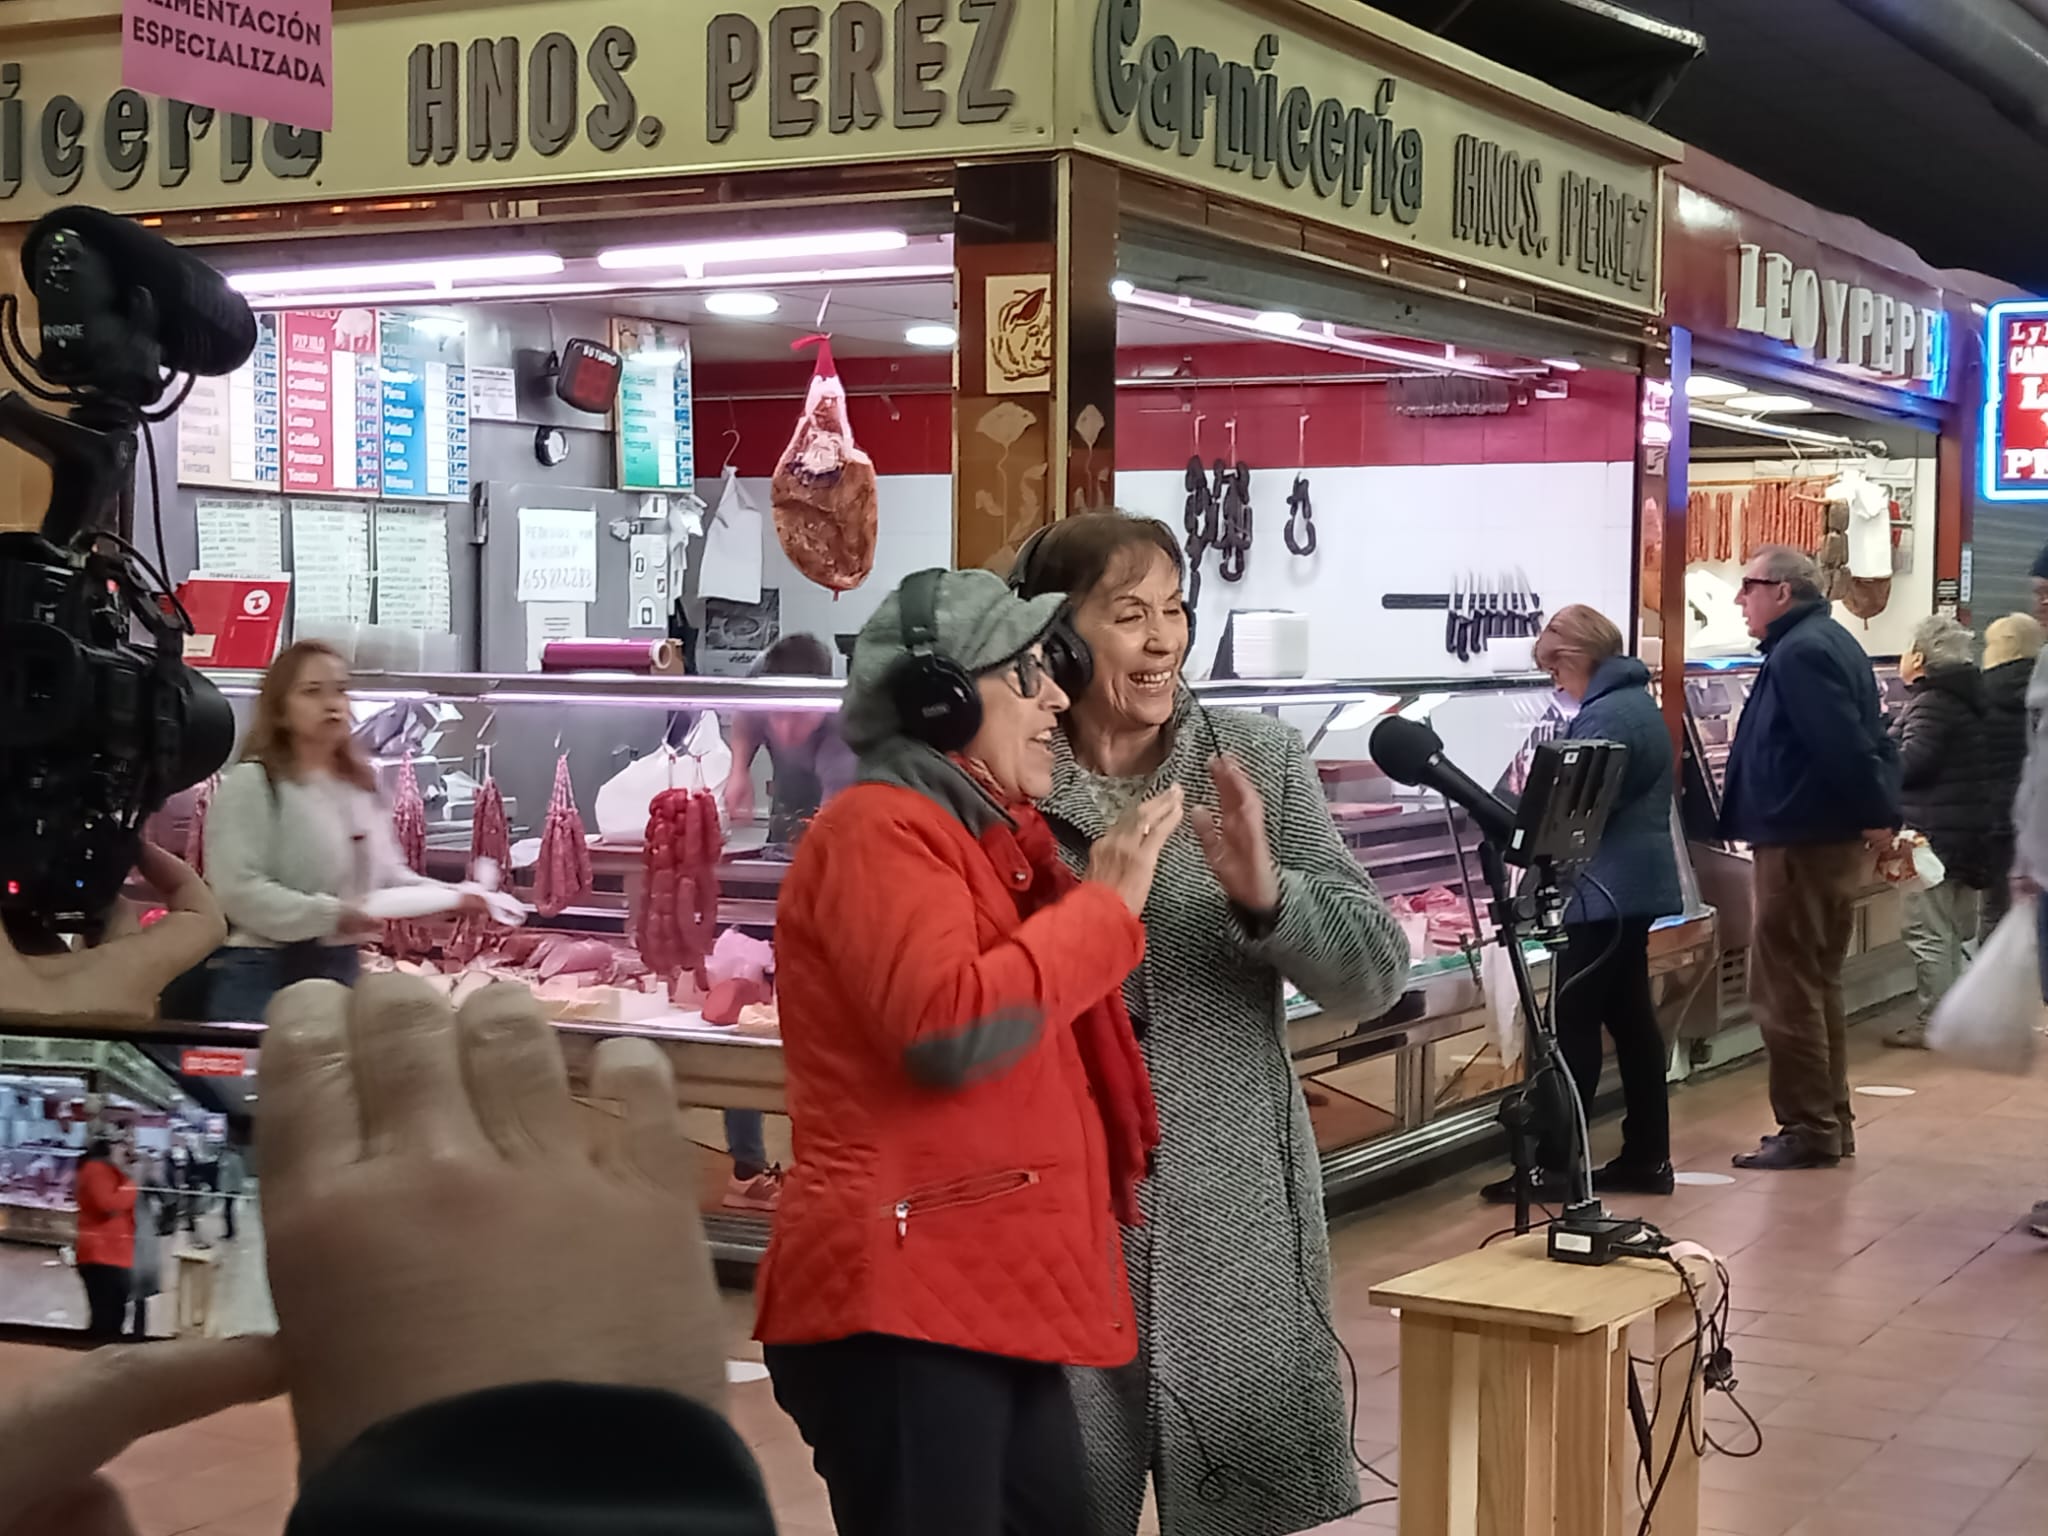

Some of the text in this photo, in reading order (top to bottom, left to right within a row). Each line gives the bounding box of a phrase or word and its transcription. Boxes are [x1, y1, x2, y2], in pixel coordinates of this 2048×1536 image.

[132, 15, 327, 88] ESPECIALIZADA
[147, 0, 321, 46] MENTACIÓN
[407, 25, 665, 166] HNOS.
[705, 0, 1017, 143] PEREZ
[1093, 0, 1651, 293] Carnicería HNOS. PEREZ
[2009, 321, 2048, 346] Ly
